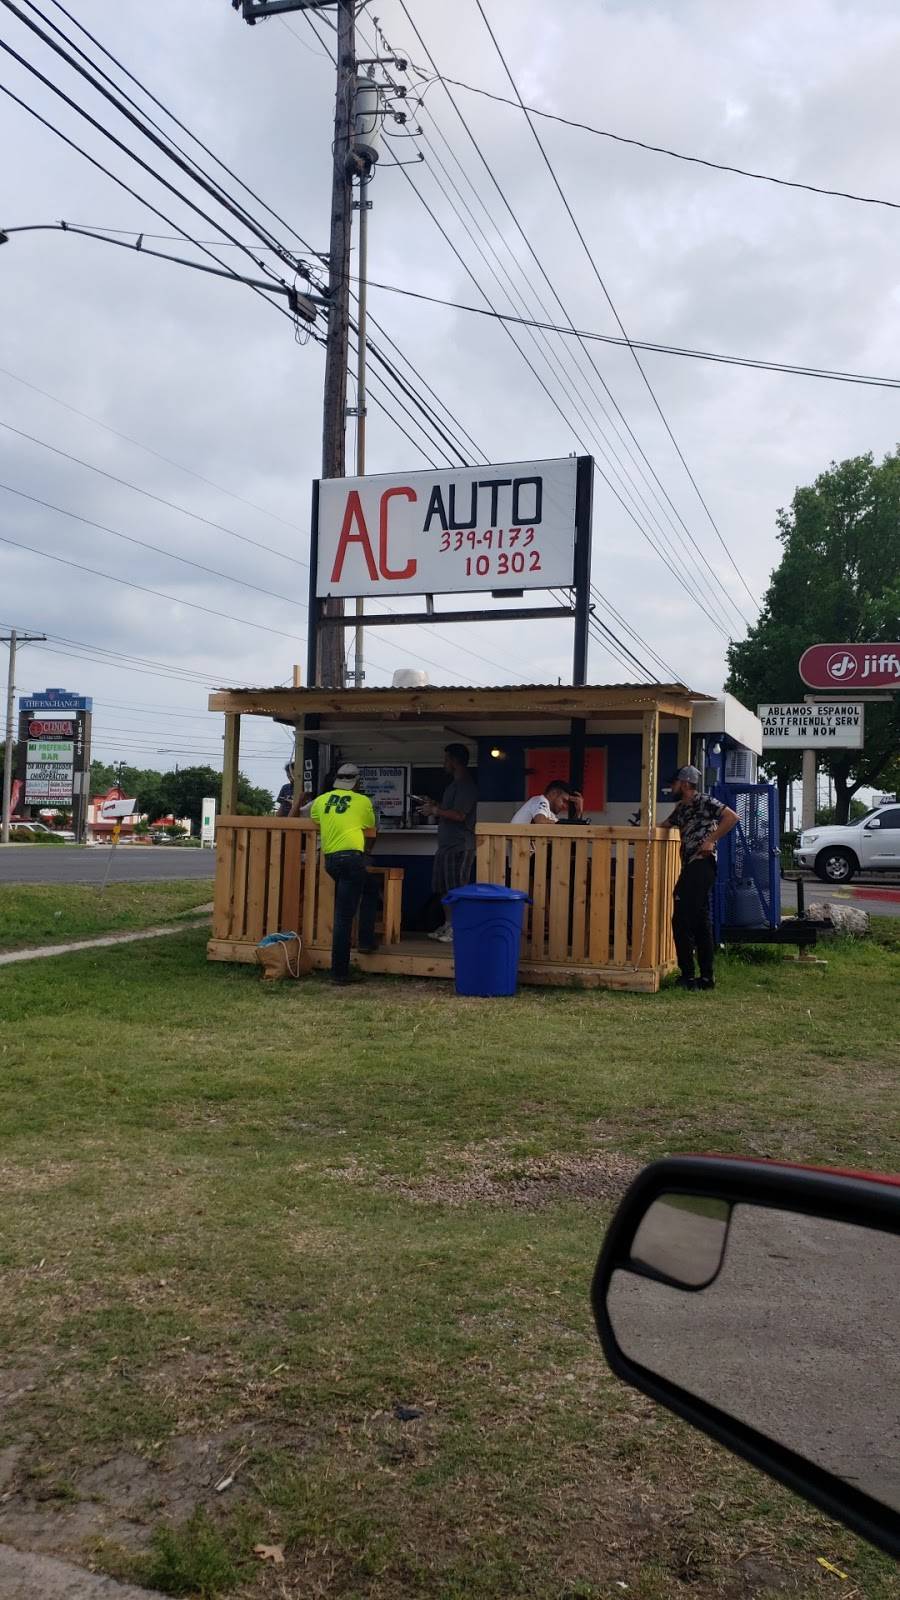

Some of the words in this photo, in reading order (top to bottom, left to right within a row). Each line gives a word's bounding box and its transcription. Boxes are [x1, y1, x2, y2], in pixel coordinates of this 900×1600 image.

[330, 486, 417, 583] AC
[423, 476, 543, 532] AUTO
[439, 527, 535, 552] 339-9173
[465, 550, 542, 576] 10302
[39, 700, 80, 708] EXCHANGE
[768, 706, 812, 716] ABLAMOS
[818, 706, 860, 715] ESPANOL
[787, 717, 832, 726] FRIENDLY
[835, 717, 859, 725] SERV
[43, 721, 73, 735] CLINICA
[763, 727, 789, 736] DRIVE
[798, 727, 807, 735] IN
[813, 727, 836, 735] NOW
